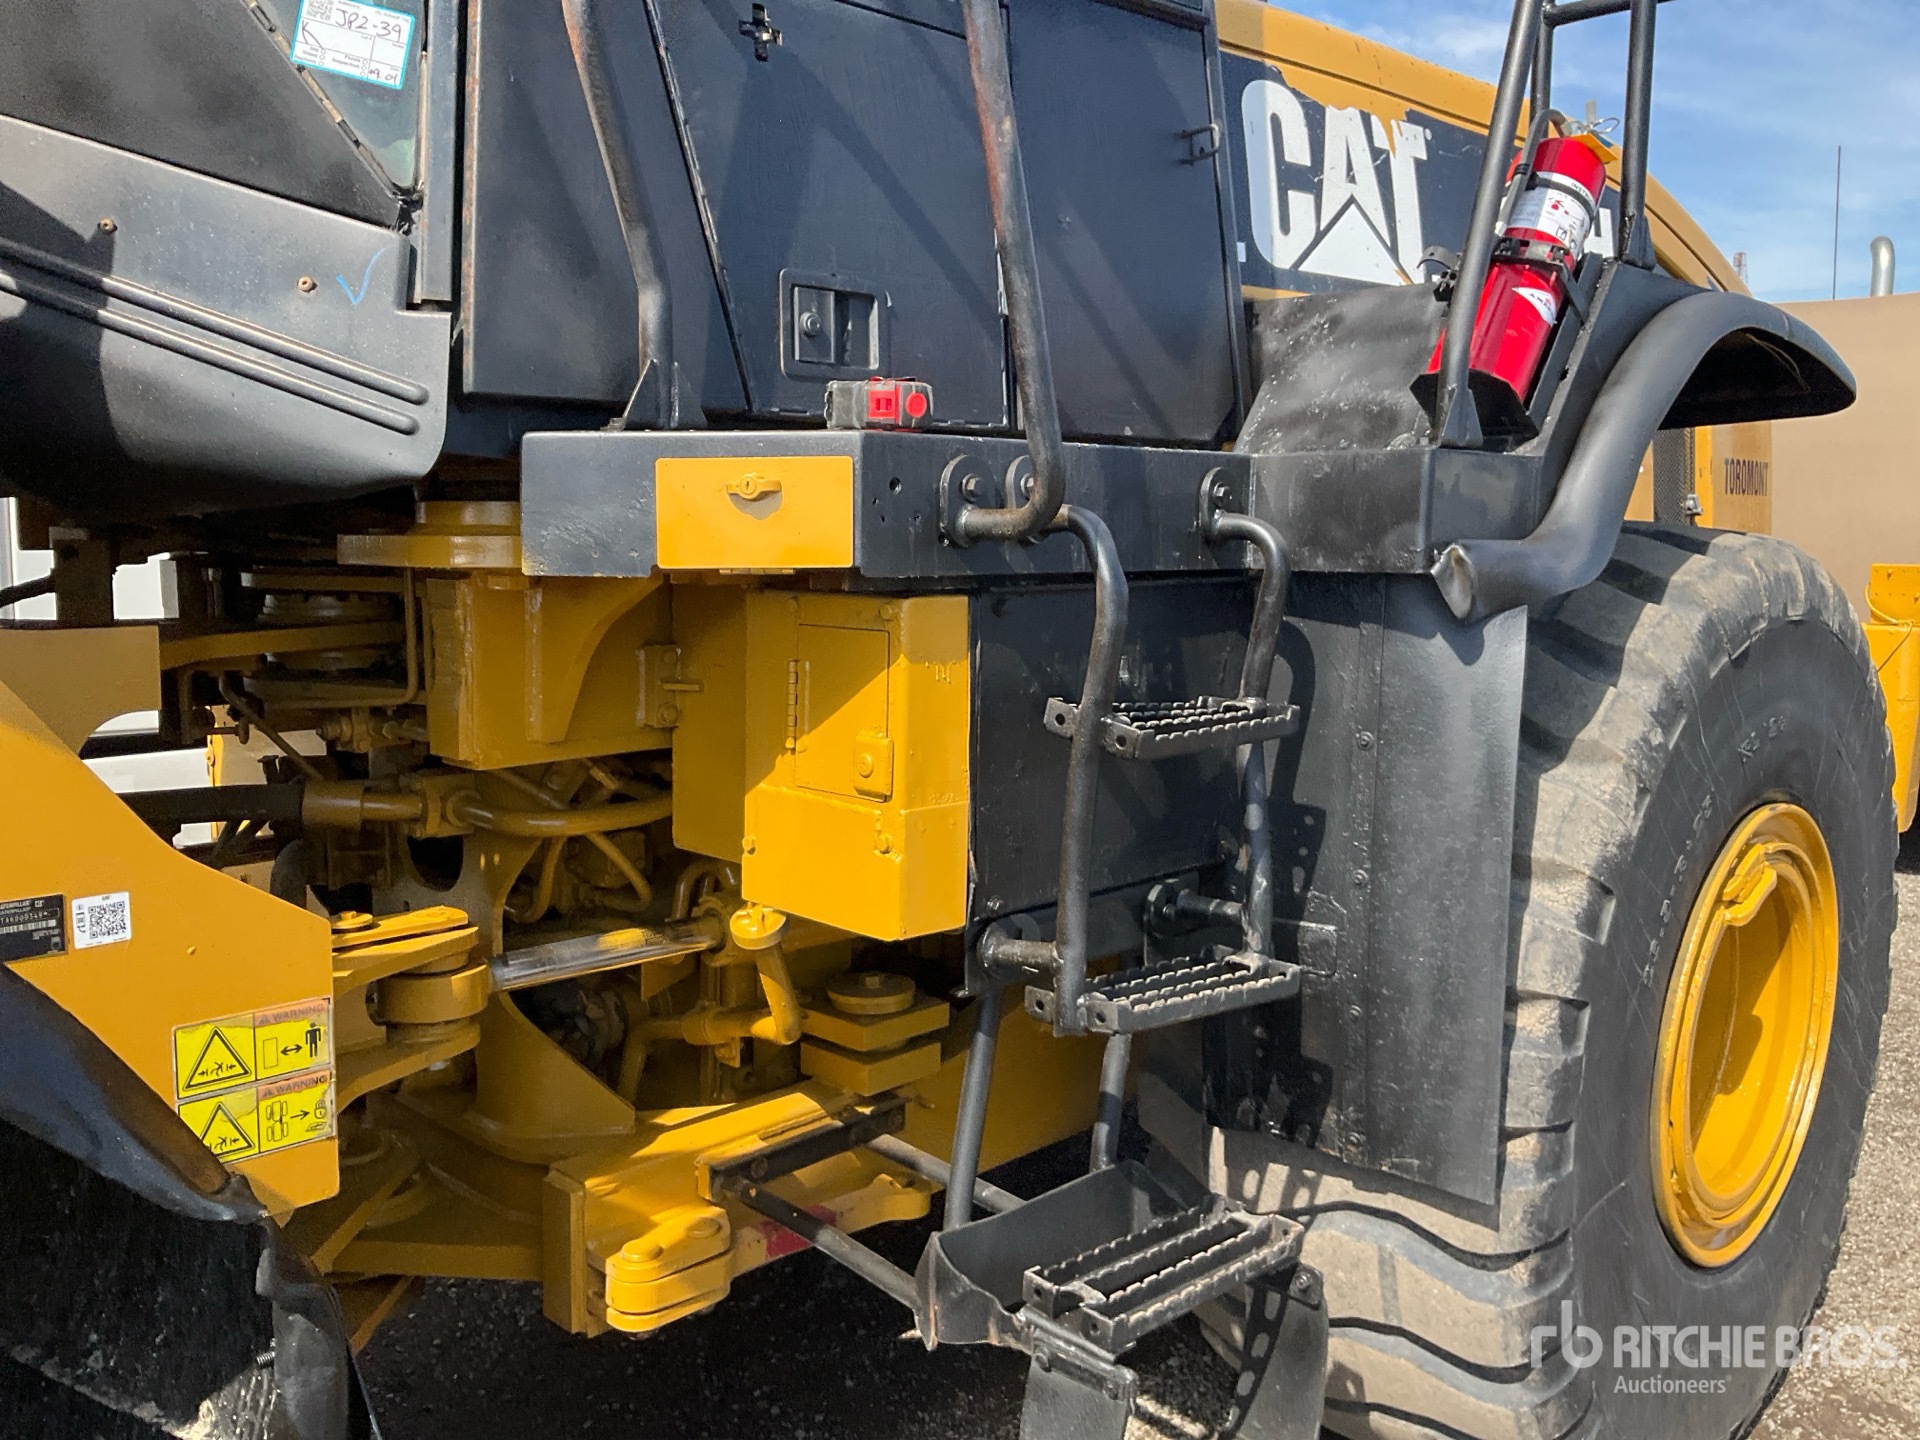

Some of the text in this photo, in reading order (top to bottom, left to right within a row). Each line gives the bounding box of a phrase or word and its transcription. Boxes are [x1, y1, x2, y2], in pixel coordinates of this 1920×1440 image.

[1241, 80, 1428, 285] CAT
[1724, 458, 1768, 496] TOROMONT
[272, 1004, 324, 1021] WARNING
[275, 1075, 327, 1094] WARNING
